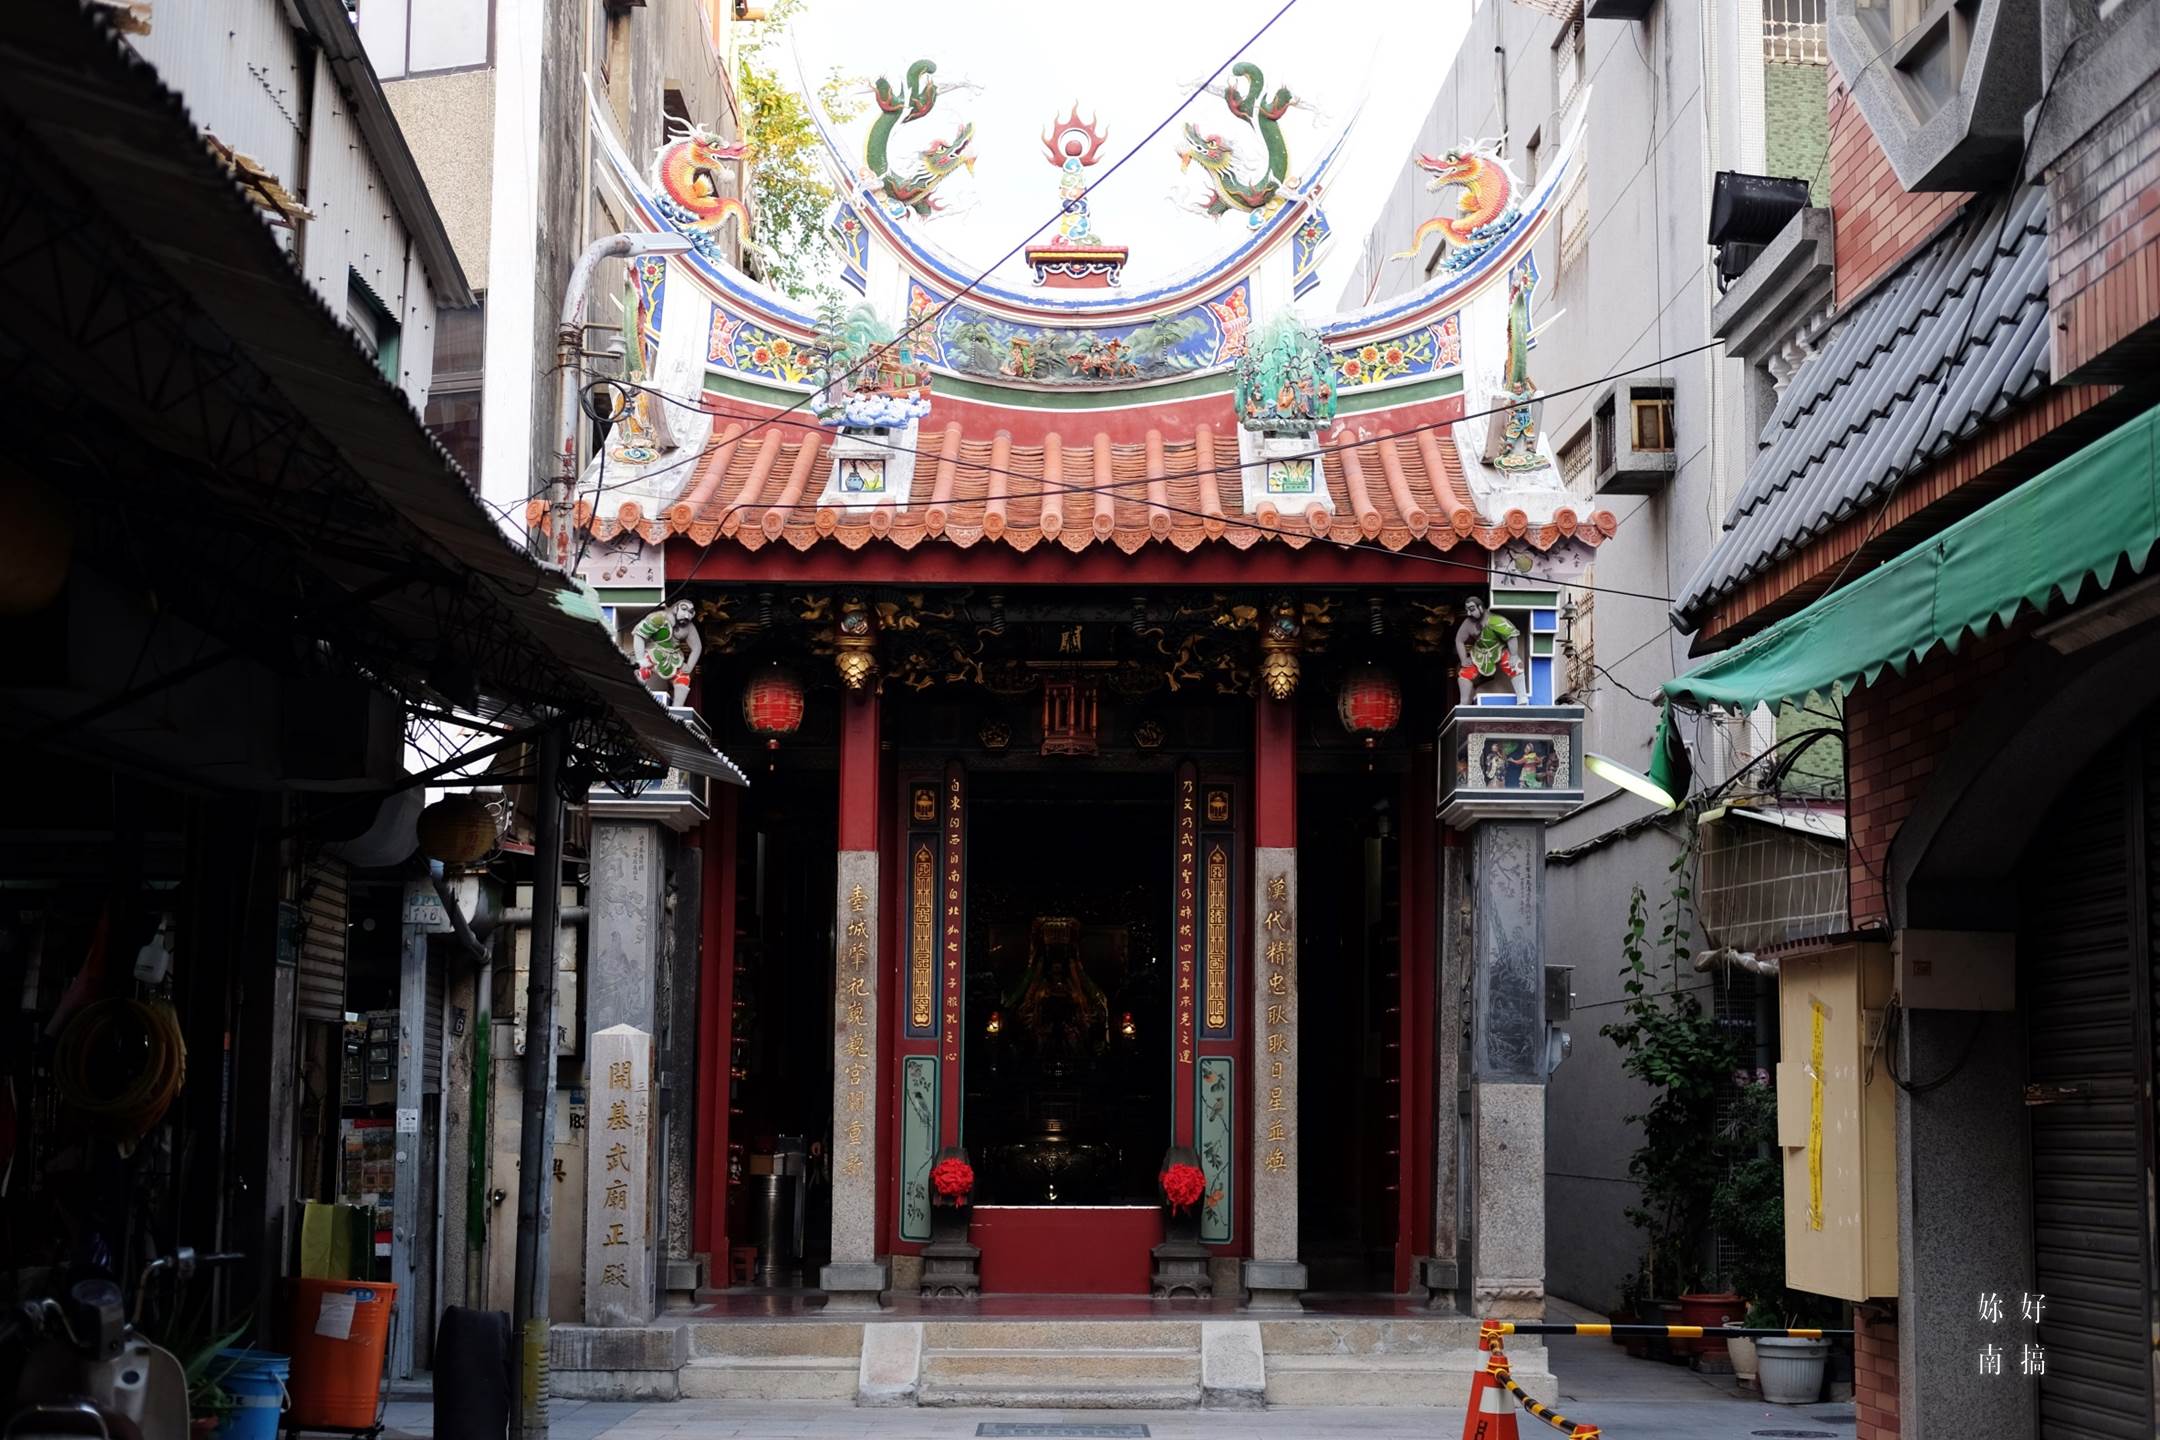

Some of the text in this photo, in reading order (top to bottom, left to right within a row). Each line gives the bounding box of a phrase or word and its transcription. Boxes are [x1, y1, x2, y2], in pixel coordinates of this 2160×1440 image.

[600, 1060, 632, 1289] 開基武廟正殿
